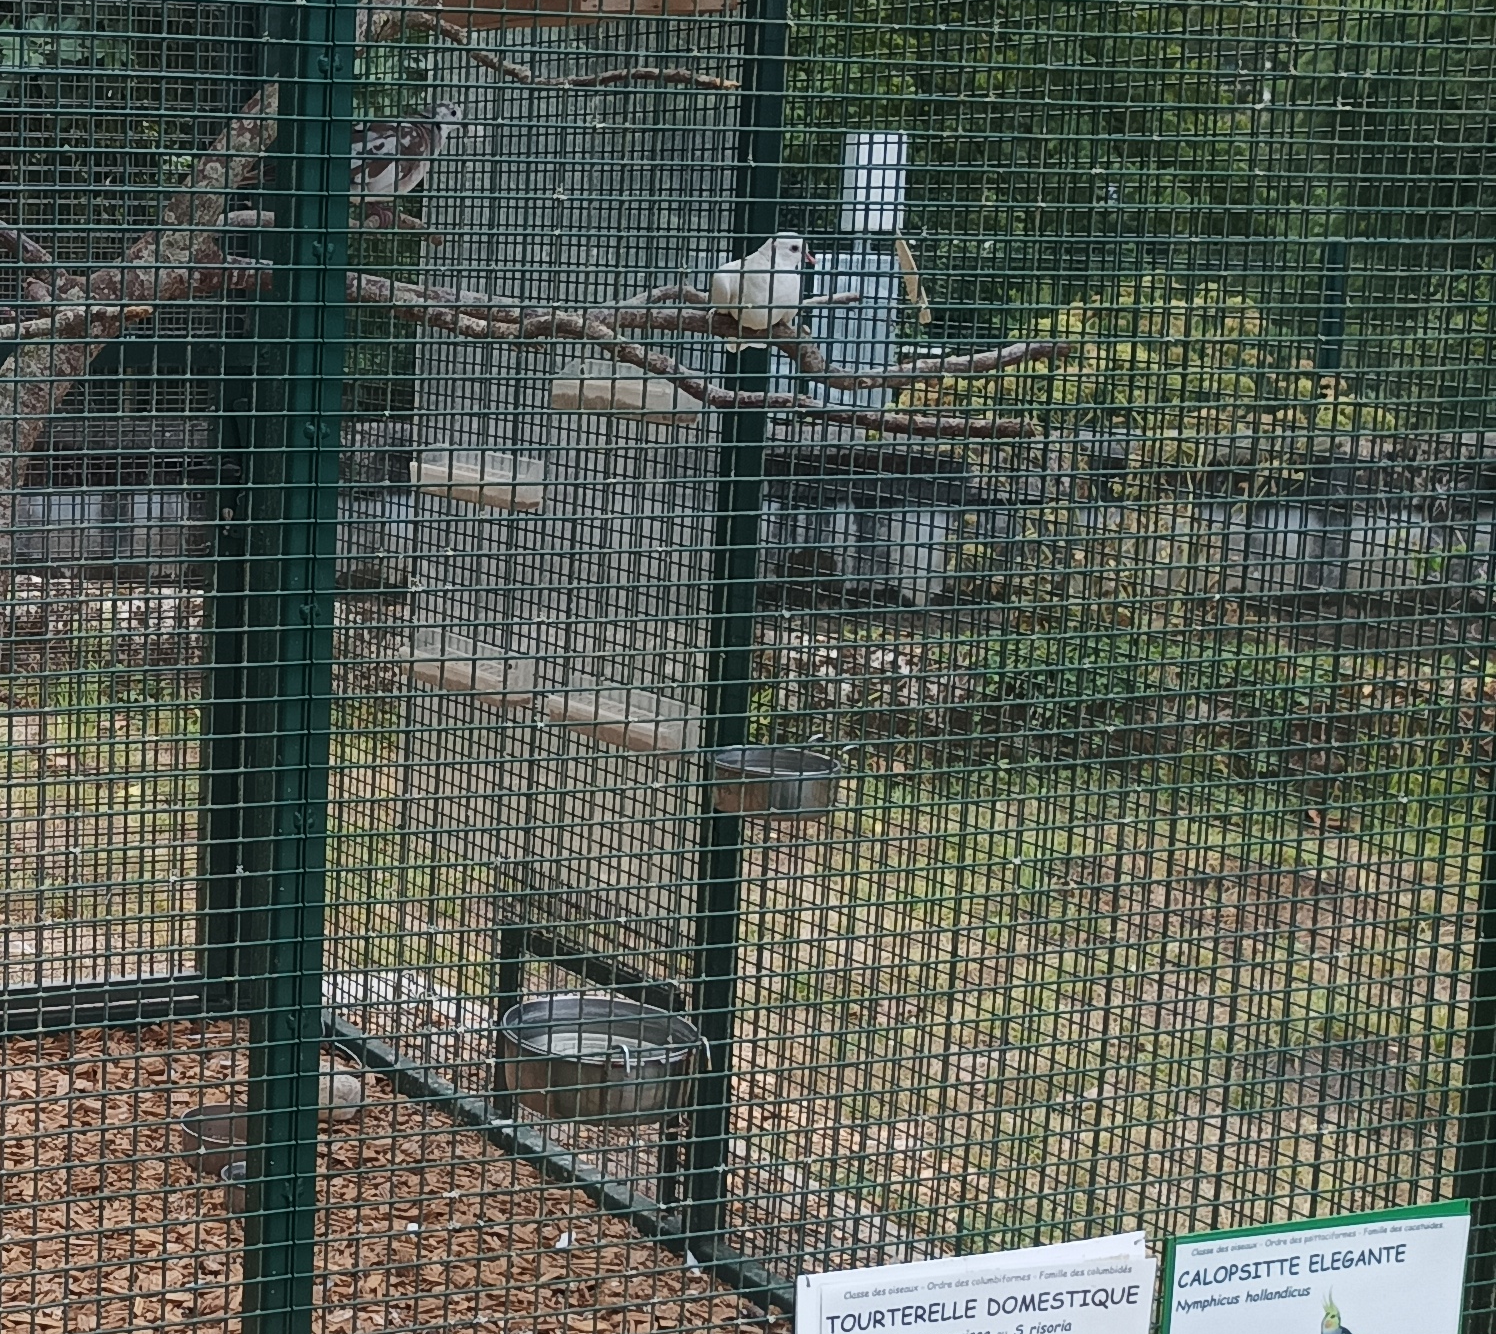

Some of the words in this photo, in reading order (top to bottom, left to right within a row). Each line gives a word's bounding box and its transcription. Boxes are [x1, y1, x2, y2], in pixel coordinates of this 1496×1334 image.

[1177, 1256, 1301, 1288] CALOPSITTE
[1308, 1244, 1406, 1273] ELEGANTE
[826, 1300, 976, 1333] TOURTERELLE
[987, 1285, 1139, 1316] DOMESTIQUE
[1176, 1294, 1240, 1313] Nymphicus
[1245, 1286, 1310, 1302] hollandicus
[1029, 1320, 1072, 1334] risoria
